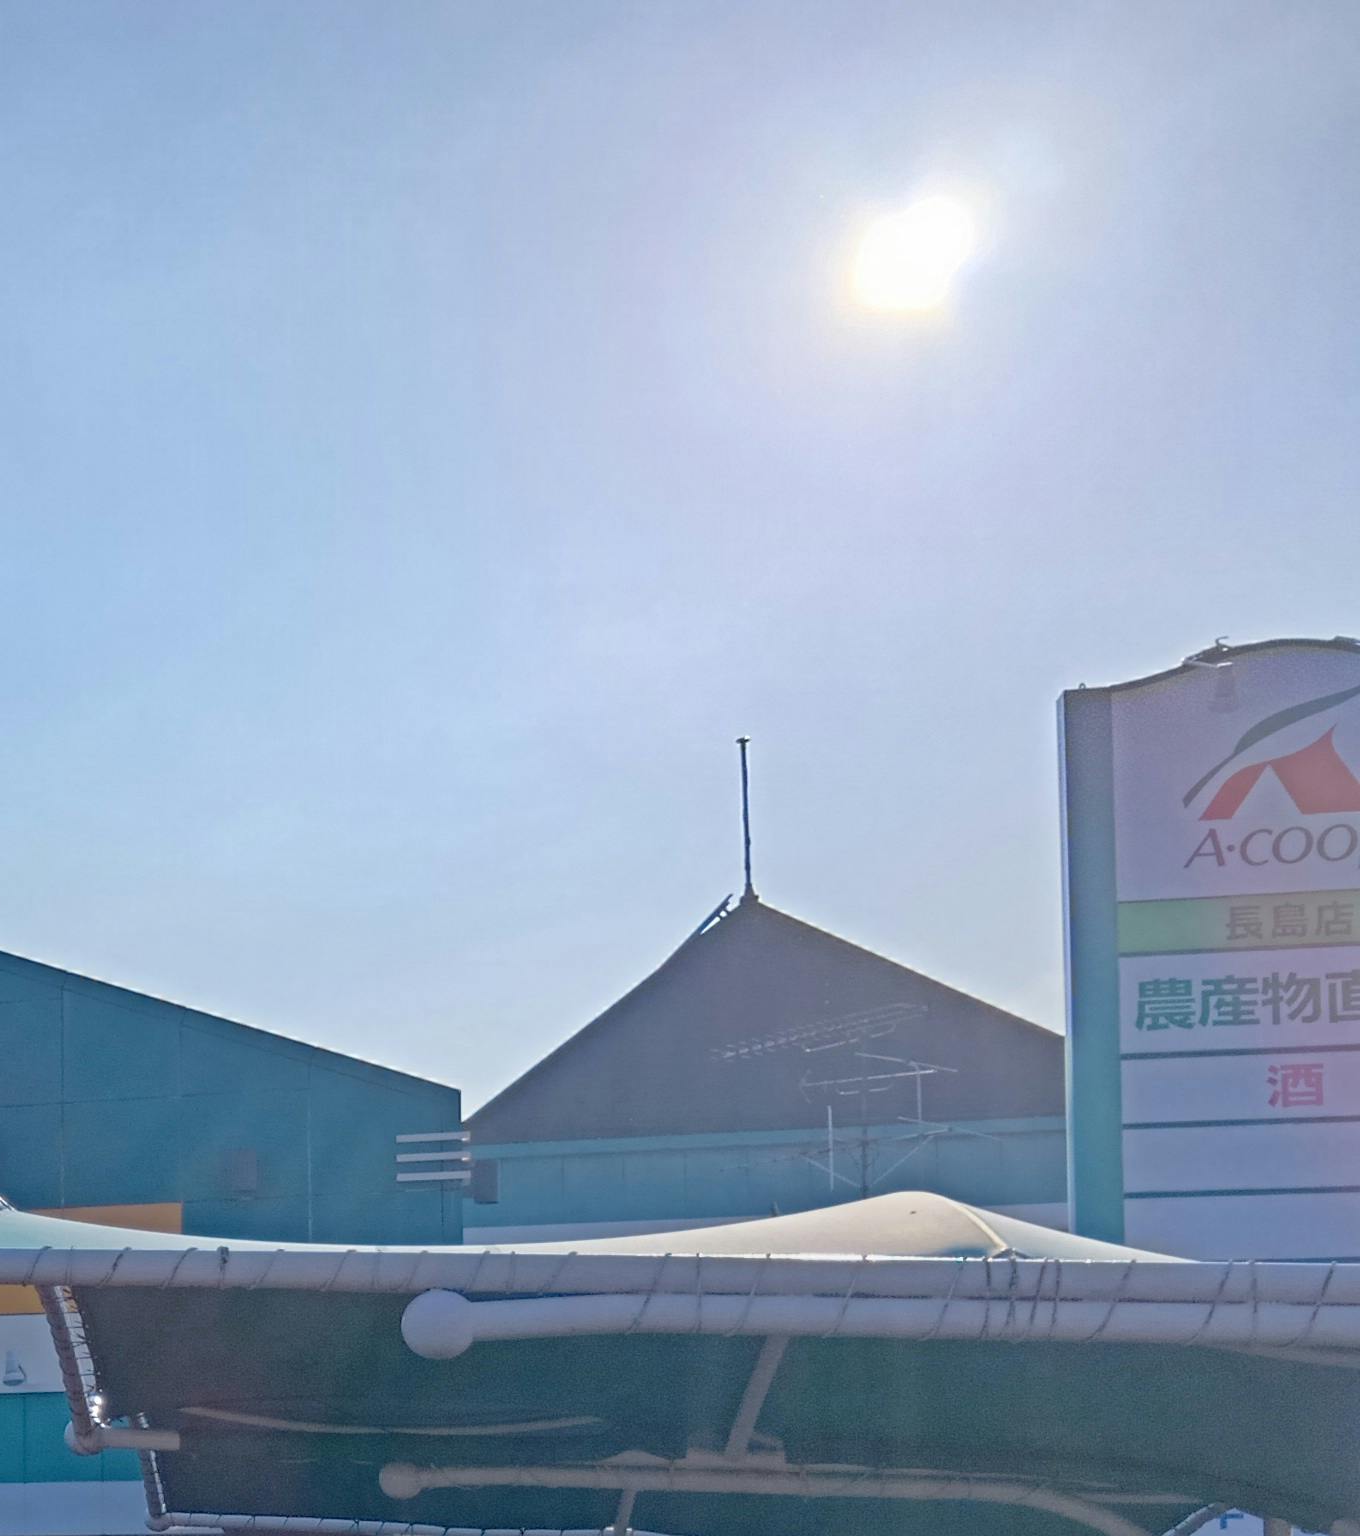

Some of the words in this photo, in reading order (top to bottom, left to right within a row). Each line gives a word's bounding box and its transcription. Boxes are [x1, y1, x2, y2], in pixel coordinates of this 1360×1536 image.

[1183, 822, 1360, 869] A·COO
[1225, 901, 1355, 942] 長島店
[1266, 1062, 1325, 1108] 酒
